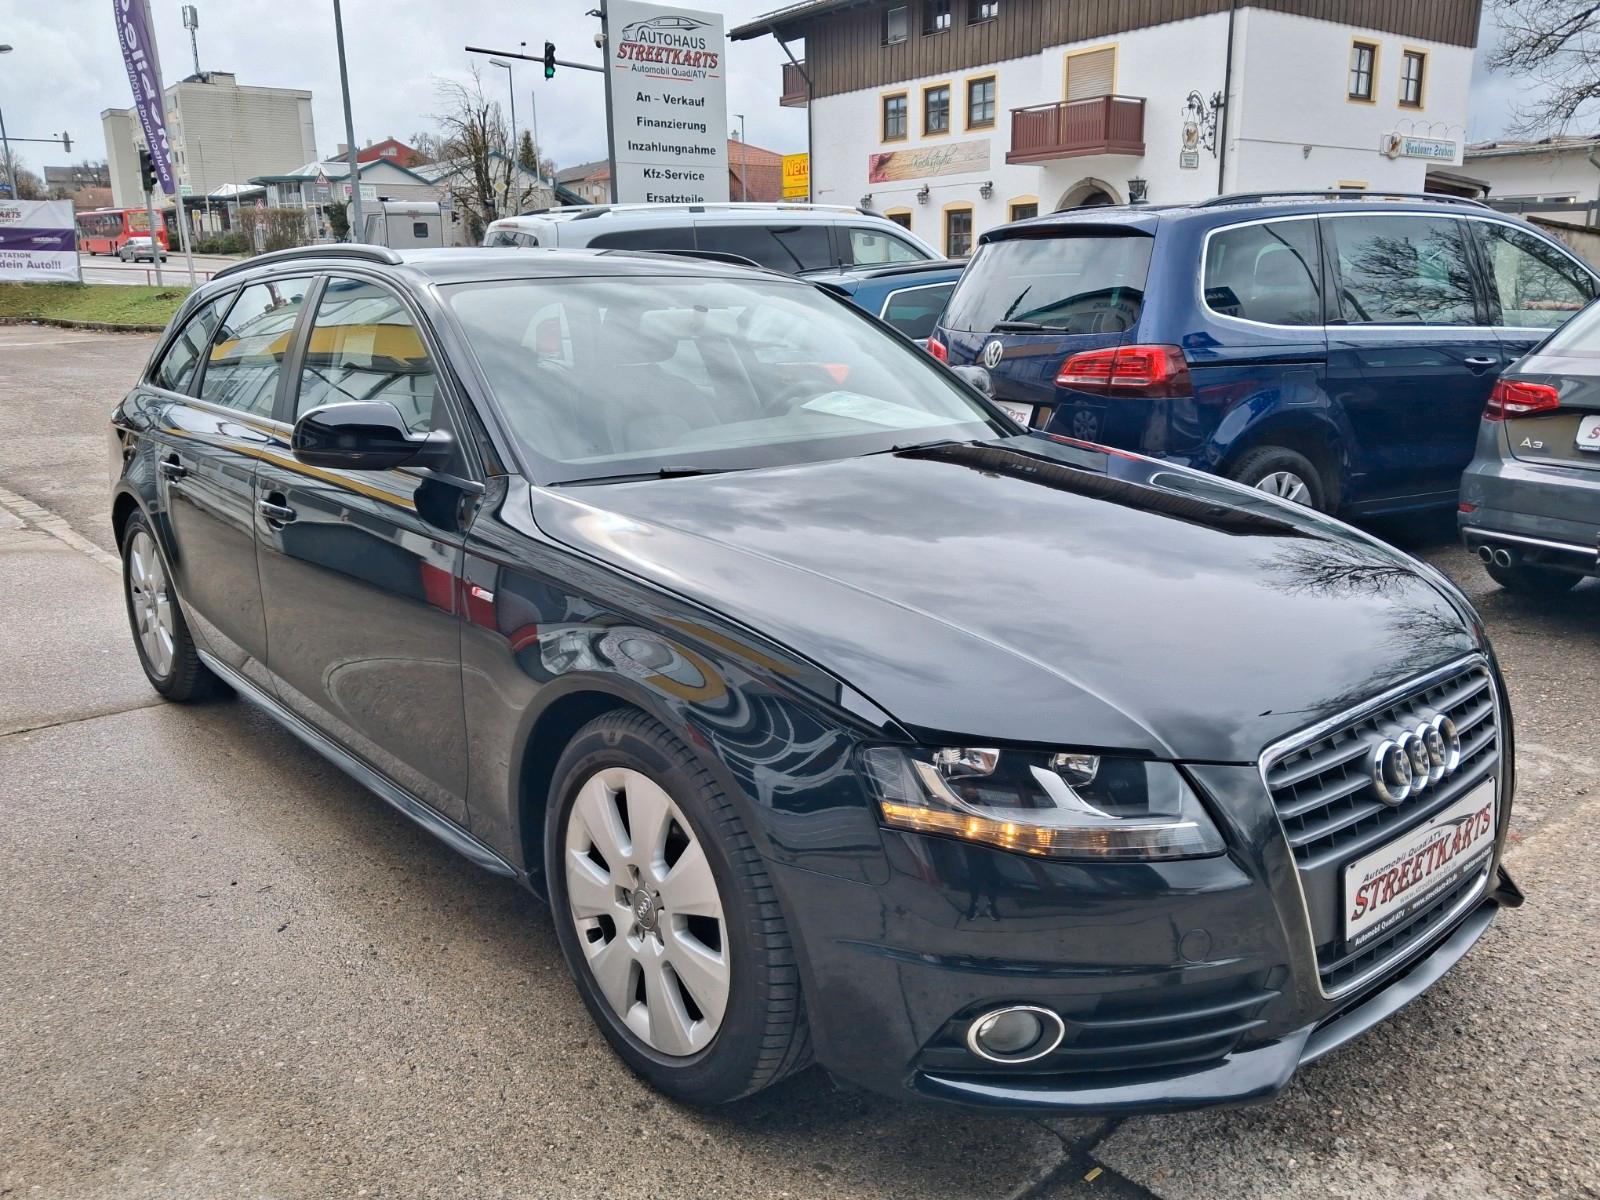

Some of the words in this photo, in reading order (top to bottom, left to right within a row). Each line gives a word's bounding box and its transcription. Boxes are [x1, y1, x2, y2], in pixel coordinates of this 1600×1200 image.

[638, 31, 706, 50] AUTOHAUS
[616, 42, 718, 69] STREETKARTS
[631, 64, 670, 76] Automobil
[671, 67, 707, 79] Quad/ATV
[636, 92, 651, 103] An
[663, 94, 705, 107] Verkauf
[637, 116, 707, 133] Finanzierung
[628, 140, 716, 156] Inzahlungnahme
[643, 168, 705, 181] Kfz-Service
[785, 158, 808, 176] Nett
[646, 193, 704, 203] Ersatzteile
[0, 260, 23, 268] dein
[27, 260, 61, 269] Auto!!!
[1519, 437, 1543, 449] A3
[1351, 802, 1492, 922] STREETKARTS
[1362, 853, 1406, 882] Automobil
